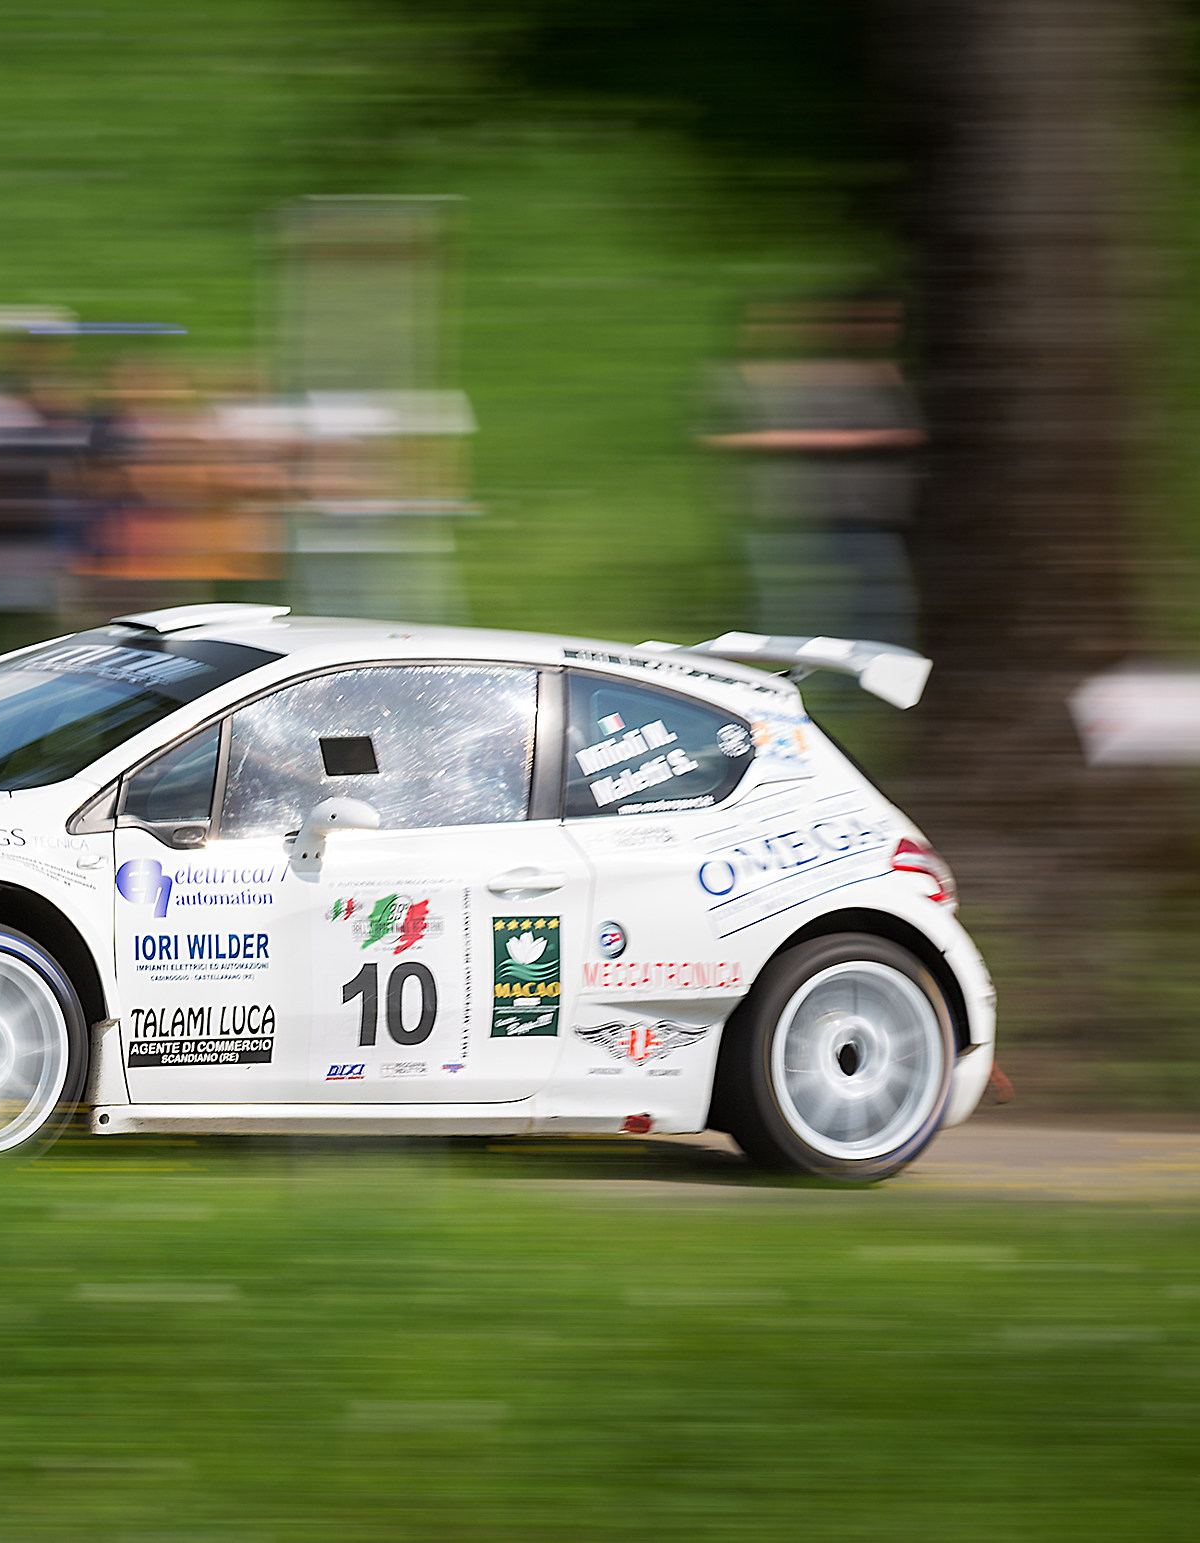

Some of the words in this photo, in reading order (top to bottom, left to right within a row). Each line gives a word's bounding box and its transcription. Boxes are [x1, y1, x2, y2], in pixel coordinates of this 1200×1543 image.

[31, 835, 90, 851] TECNICA
[699, 819, 886, 895] OMEGA
[175, 889, 273, 906] automation
[135, 934, 179, 960] IORI
[187, 933, 269, 959] WILDER
[170, 963, 207, 971] ELETTRICI
[221, 962, 269, 970] AUTOMAZIONI
[583, 962, 743, 987] MECCATRONICA
[494, 982, 560, 998] MACAO
[342, 961, 438, 1048] 10
[130, 1006, 212, 1038] TALAMI
[220, 1004, 275, 1035] LUCA
[130, 1043, 181, 1055] AGENTE
[182, 1042, 195, 1053] DI
[197, 1039, 272, 1052] COMMERCIO
[161, 1052, 218, 1064] SCANDIANO
[219, 1052, 239, 1063] (RE)
